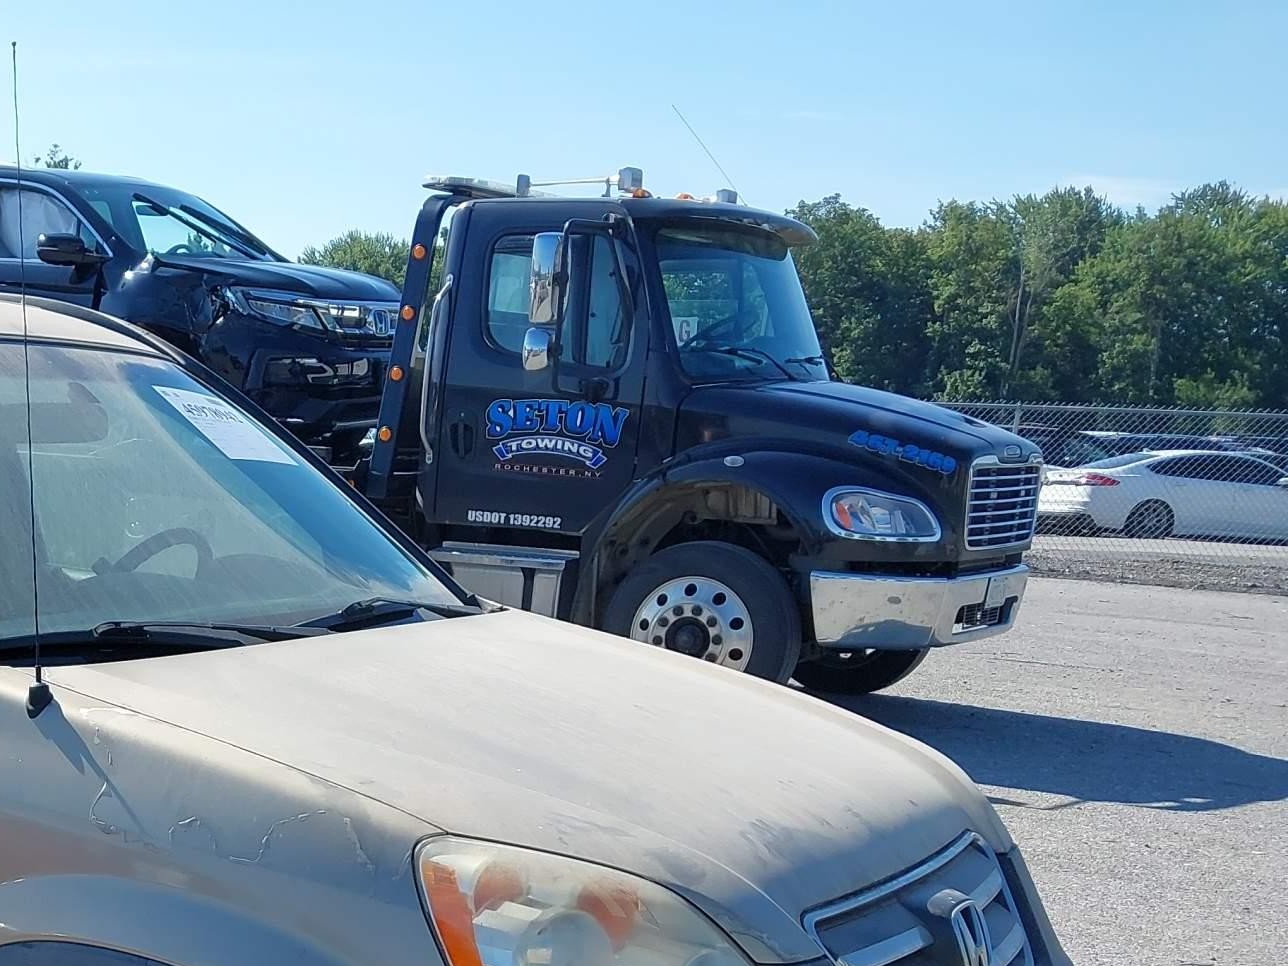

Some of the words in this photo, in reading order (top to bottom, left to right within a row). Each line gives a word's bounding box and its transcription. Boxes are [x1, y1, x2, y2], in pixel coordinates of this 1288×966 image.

[485, 399, 630, 449] SETON
[507, 438, 594, 458] TOWING
[467, 509, 507, 525] USDOT
[509, 513, 562, 530] 1392292
